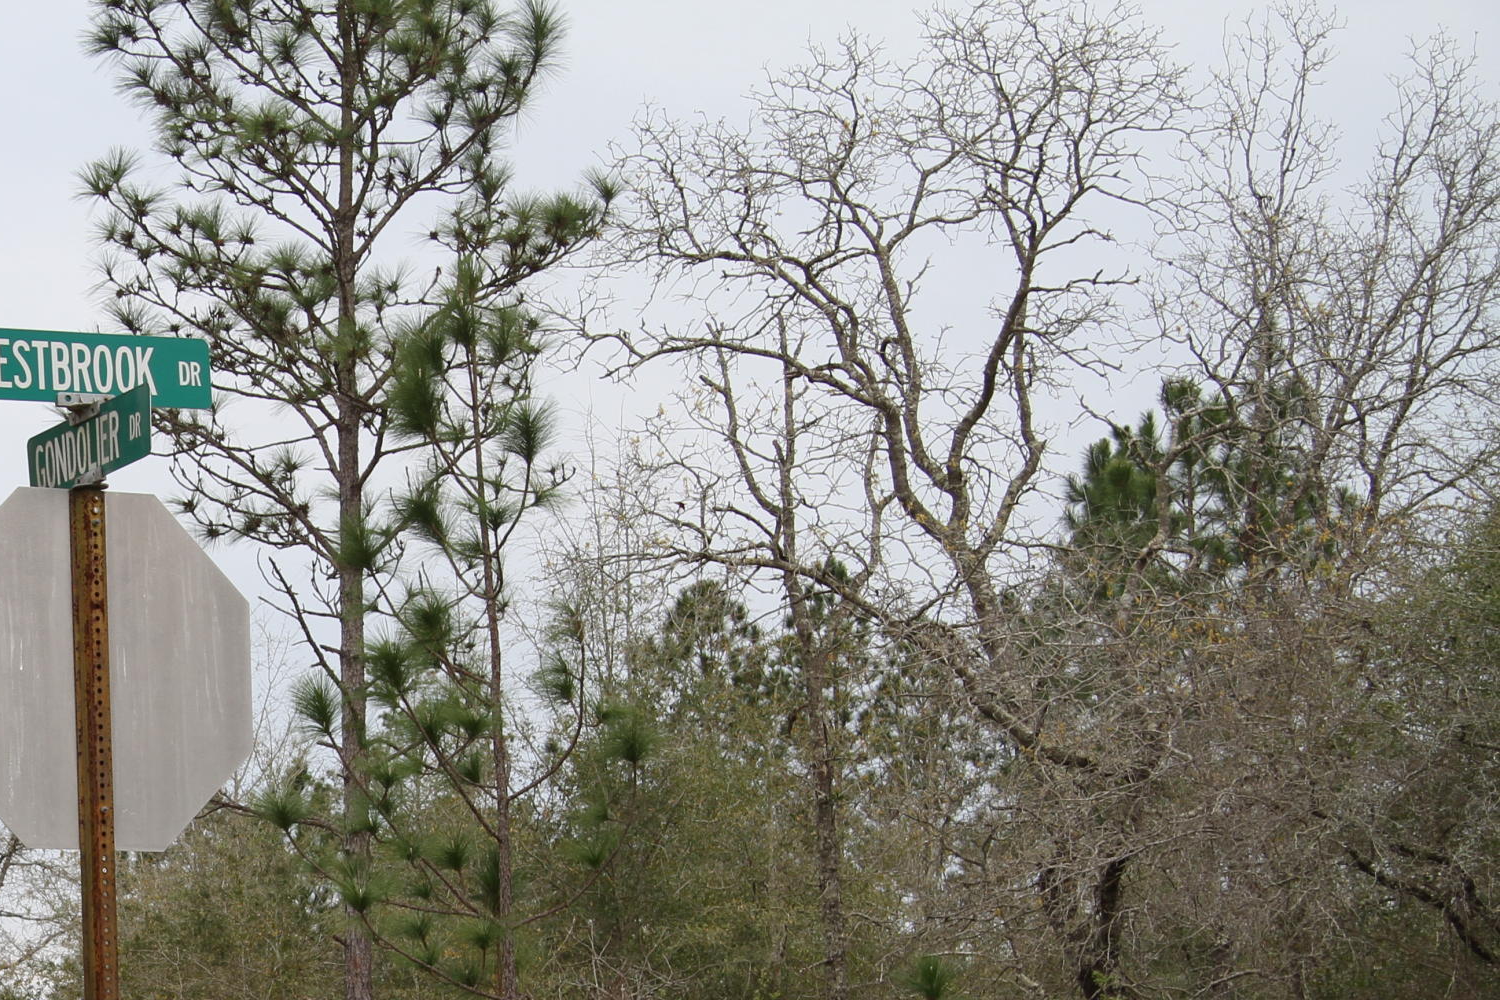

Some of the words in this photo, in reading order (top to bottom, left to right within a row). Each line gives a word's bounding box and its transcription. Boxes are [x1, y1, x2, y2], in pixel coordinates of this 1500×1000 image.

[178, 361, 202, 387] DR
[35, 410, 120, 488] GONDOLIER
[129, 411, 141, 441] DR
